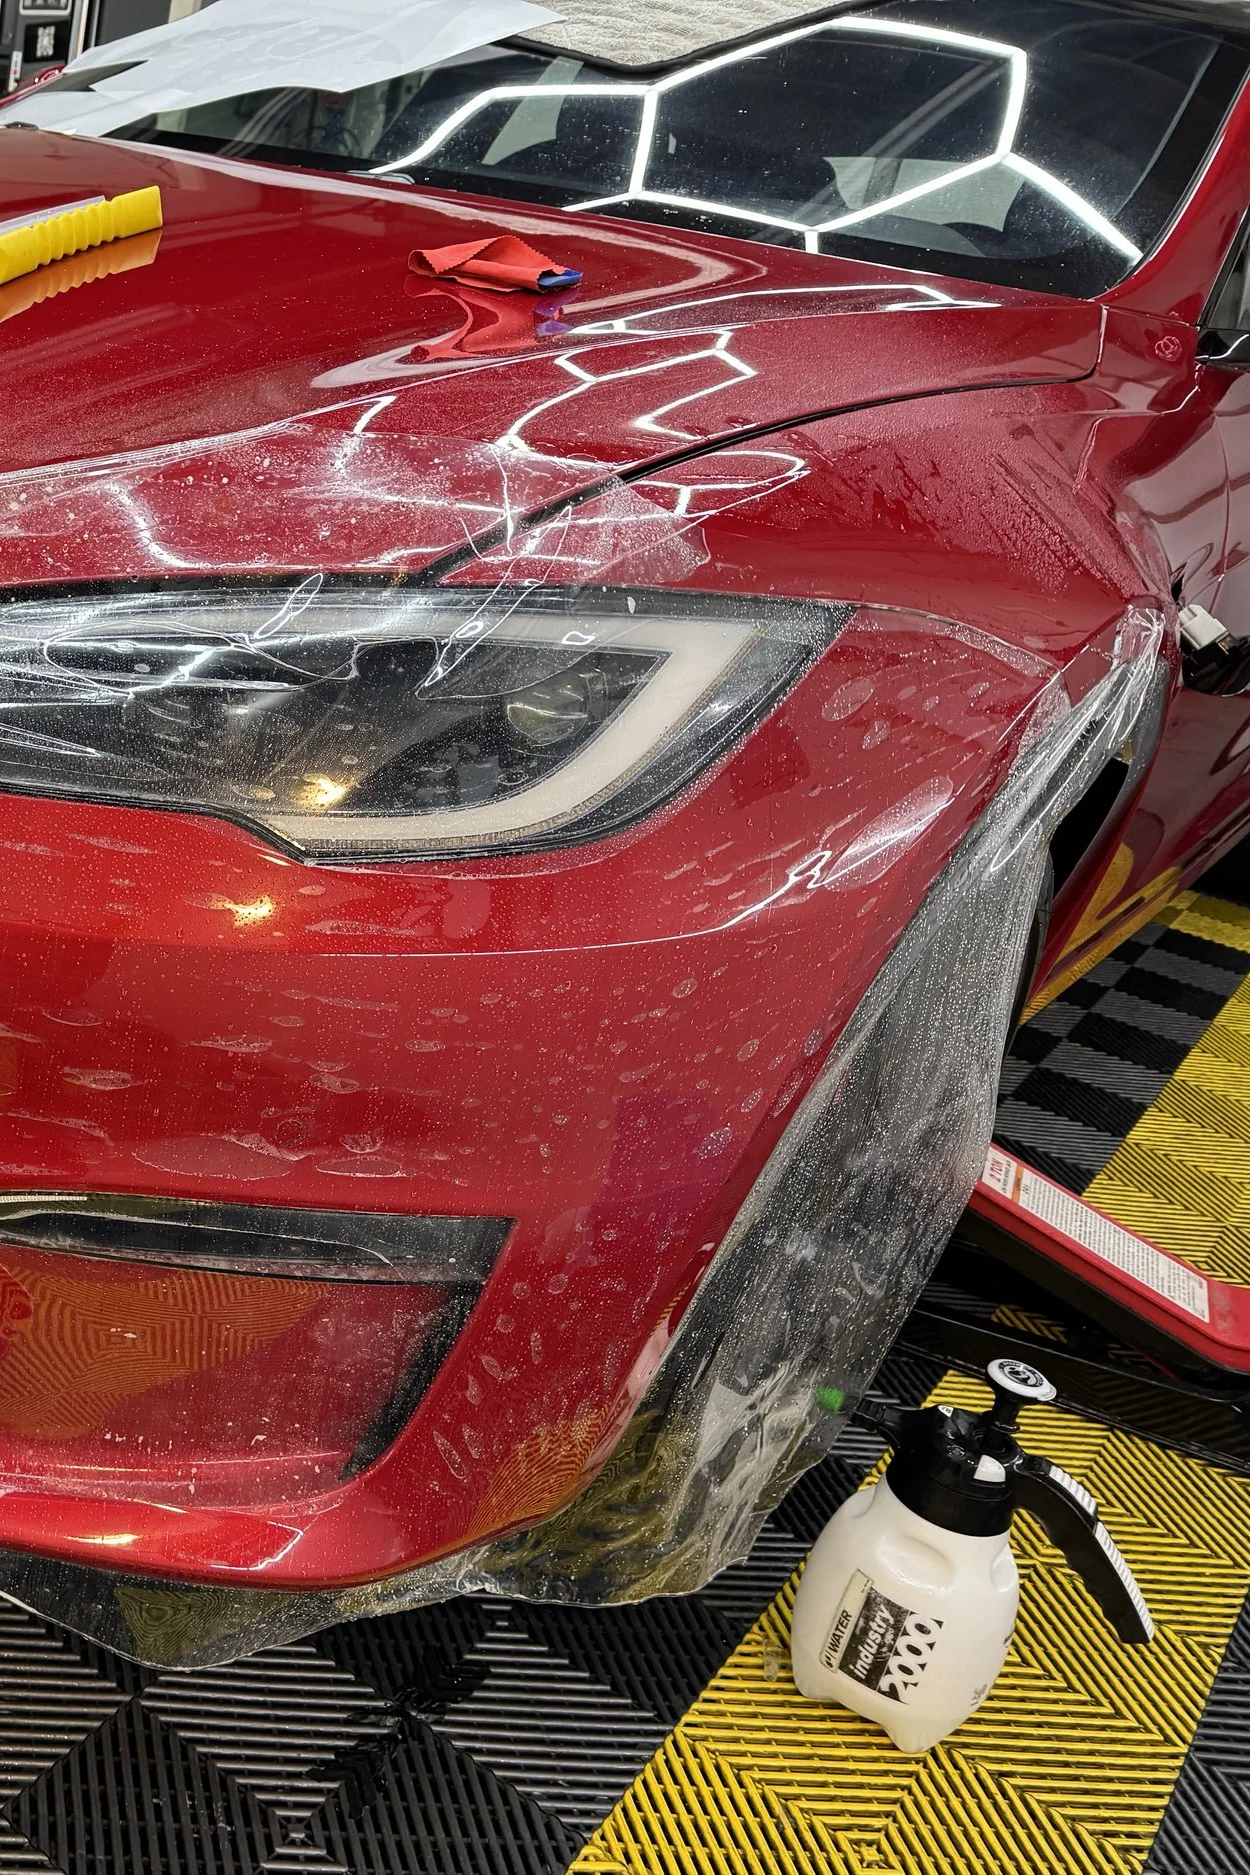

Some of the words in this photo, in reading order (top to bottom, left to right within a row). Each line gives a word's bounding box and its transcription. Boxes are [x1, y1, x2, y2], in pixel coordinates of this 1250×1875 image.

[827, 1609, 852, 1654] WATER
[849, 1604, 895, 1680] industry
[878, 1611, 942, 1704] 2000
